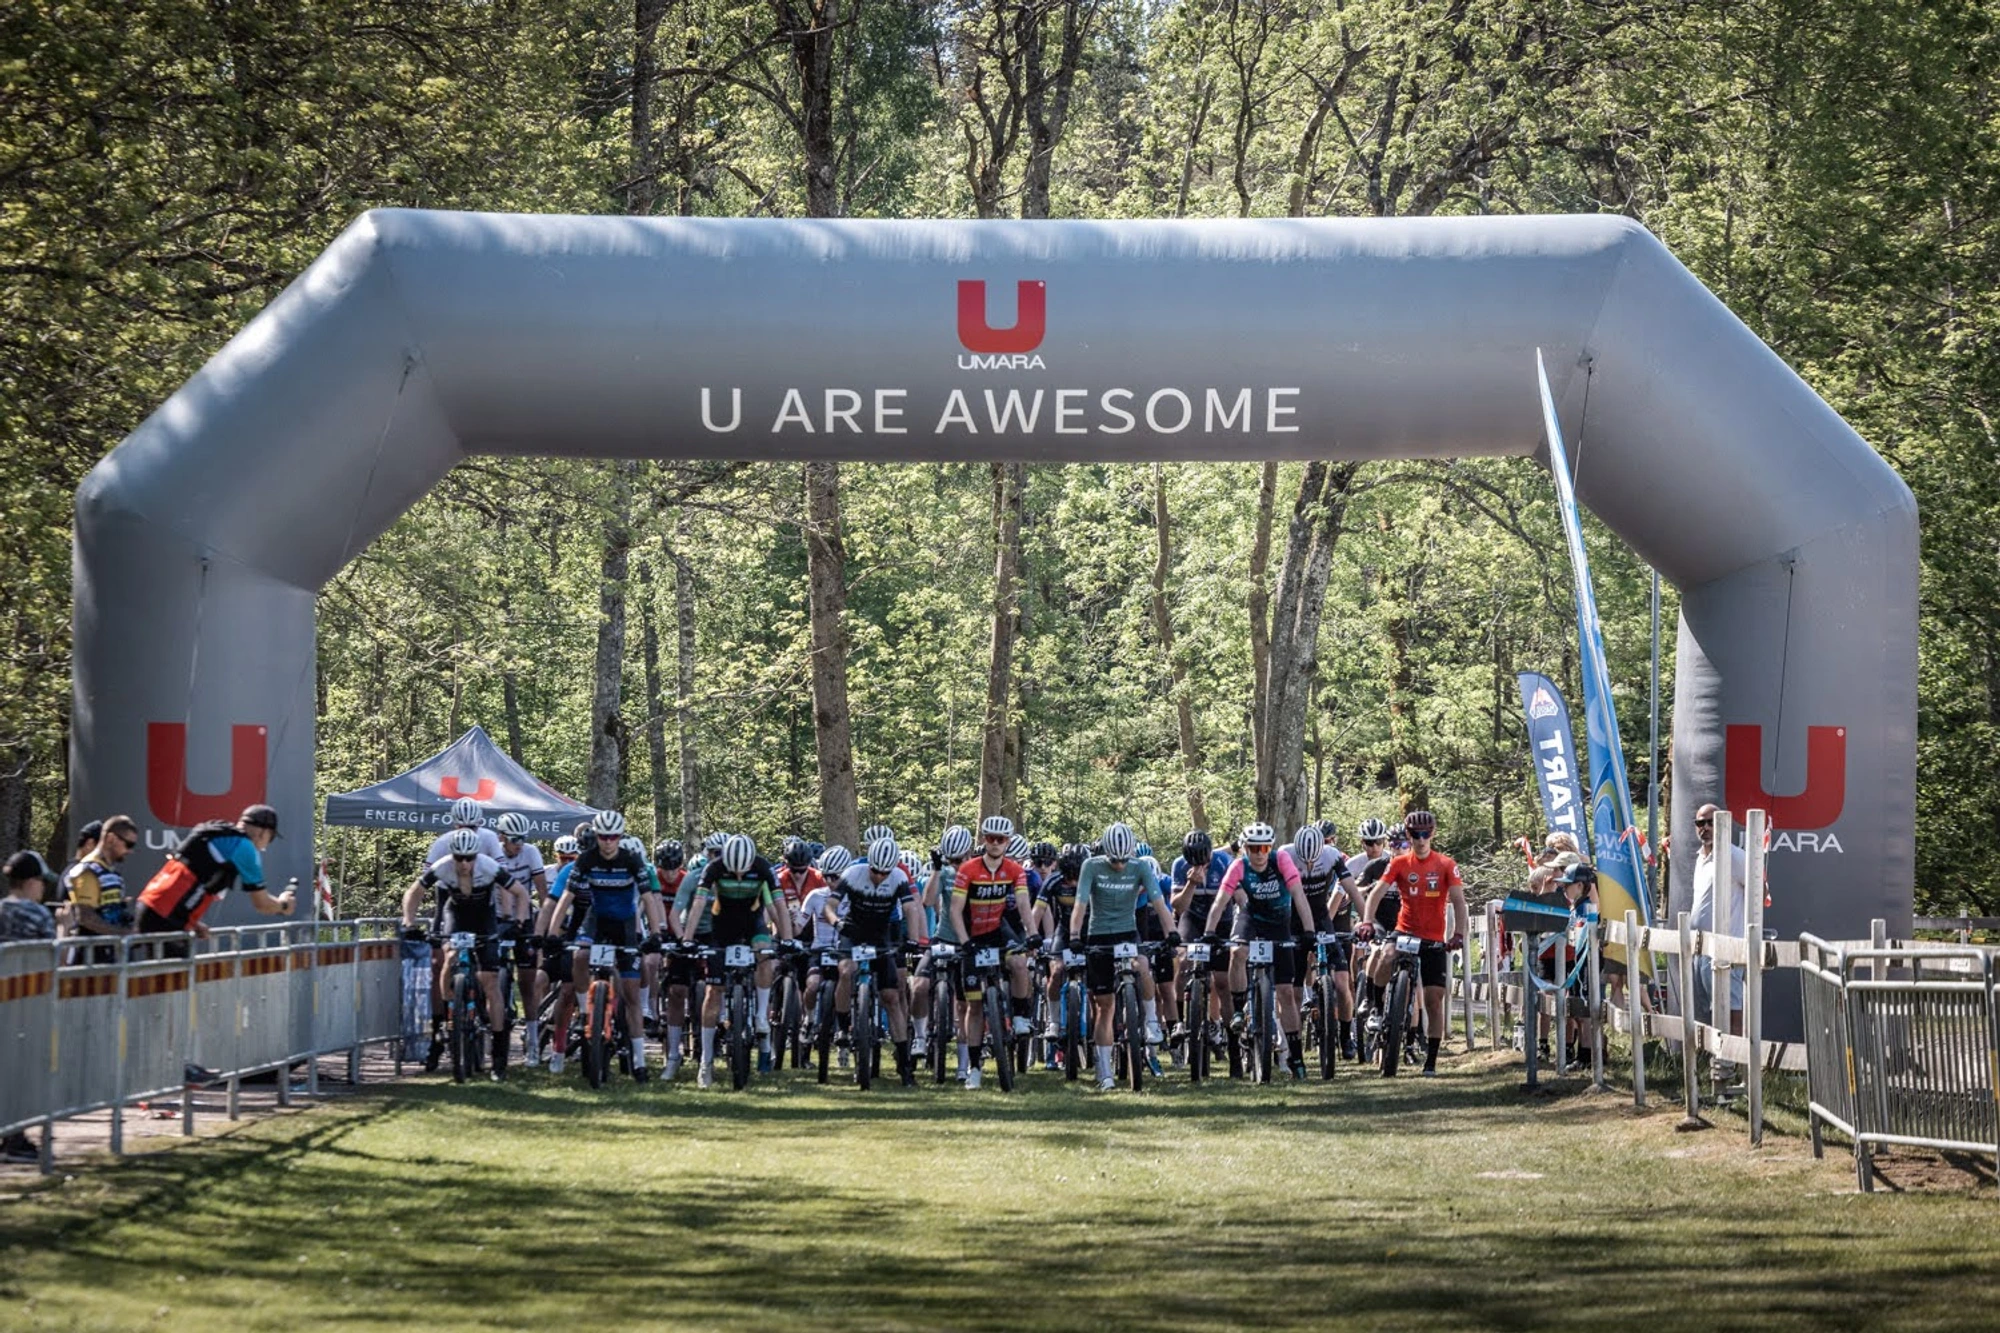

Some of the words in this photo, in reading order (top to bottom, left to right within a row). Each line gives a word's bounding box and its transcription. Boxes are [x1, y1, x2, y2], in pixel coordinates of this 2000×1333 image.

[957, 354, 1046, 370] UMARA
[701, 387, 742, 433] U
[771, 388, 907, 433] ARE
[934, 387, 1300, 434] AWESOME
[365, 809, 424, 823] ENERGI
[1258, 943, 1265, 956] 5
